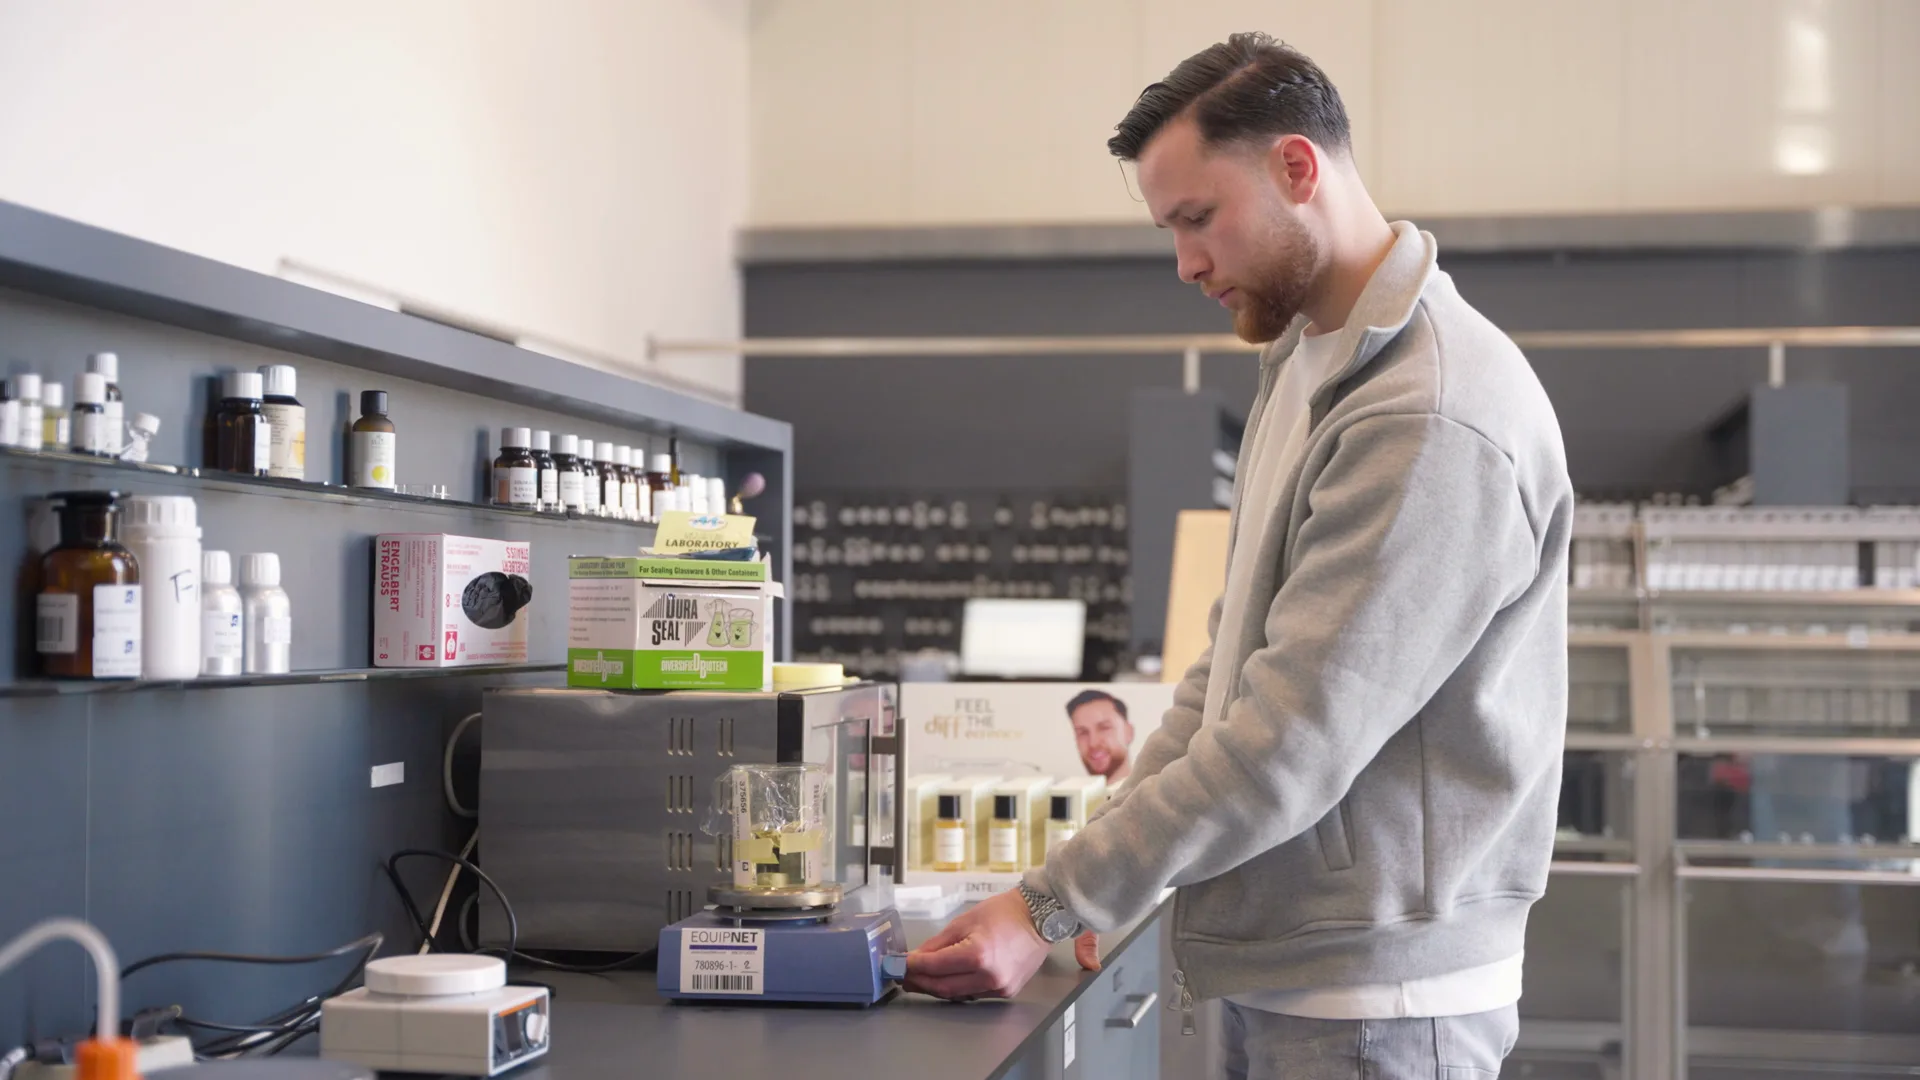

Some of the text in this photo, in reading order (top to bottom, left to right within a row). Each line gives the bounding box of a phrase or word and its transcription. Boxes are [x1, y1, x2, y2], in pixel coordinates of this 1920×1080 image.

[665, 539, 739, 549] LABORATORY
[381, 541, 390, 596] STRAUSS
[639, 566, 649, 574] For
[651, 566, 673, 576] Sealing
[674, 567, 704, 575] Glassware
[711, 568, 727, 576] Other
[728, 569, 759, 577] Containers
[390, 541, 400, 612] ENGELBERT
[665, 594, 698, 619] DURA
[652, 620, 680, 646] SEAL
[954, 698, 995, 713] FEEL
[967, 714, 994, 728] THE
[739, 781, 748, 813] 375656
[690, 931, 758, 943] EQUIPNET
[743, 960, 751, 969] 2
